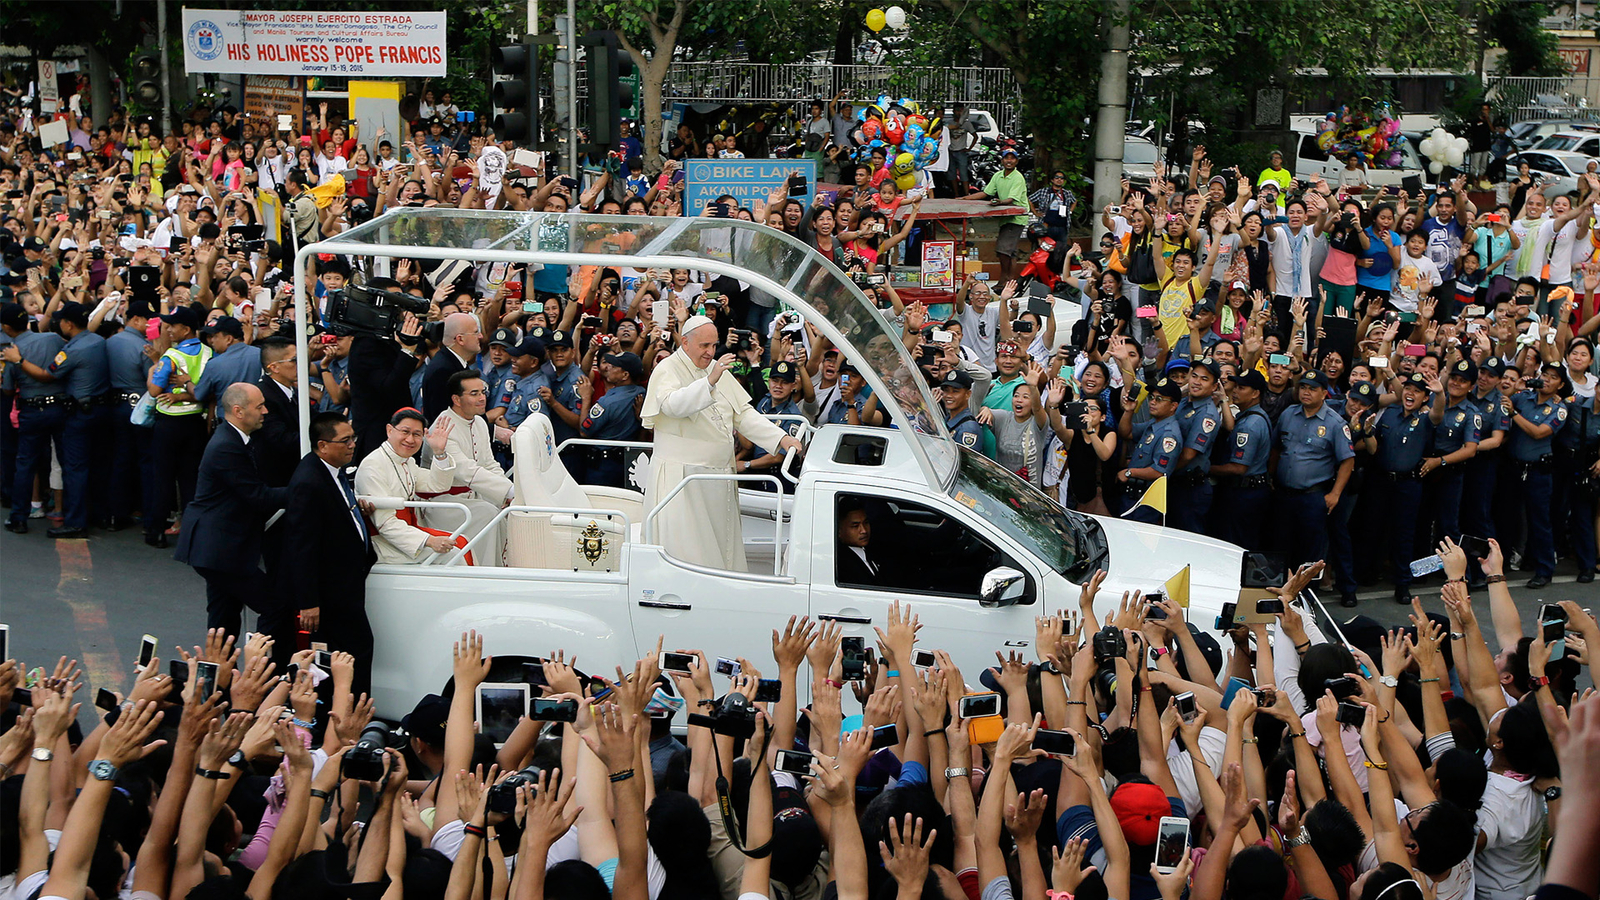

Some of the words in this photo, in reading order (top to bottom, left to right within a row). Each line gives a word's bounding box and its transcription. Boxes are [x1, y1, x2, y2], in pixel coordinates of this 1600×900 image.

[246, 14, 275, 22] MAYOR
[279, 14, 313, 23] JOSEPH
[317, 15, 361, 23] EJERCITO
[365, 16, 412, 24] ESTRADA
[227, 43, 251, 61] HIS
[257, 44, 329, 63] HOLINESS
[334, 45, 375, 63] POPE
[379, 46, 442, 64] FRANCIS
[301, 64, 328, 72] January
[246, 74, 289, 89] Welcome
[713, 166, 755, 178] BIKE
[760, 166, 806, 178] LANE
[699, 186, 748, 196] AKAYIN
[720, 795, 730, 816] Nikon
